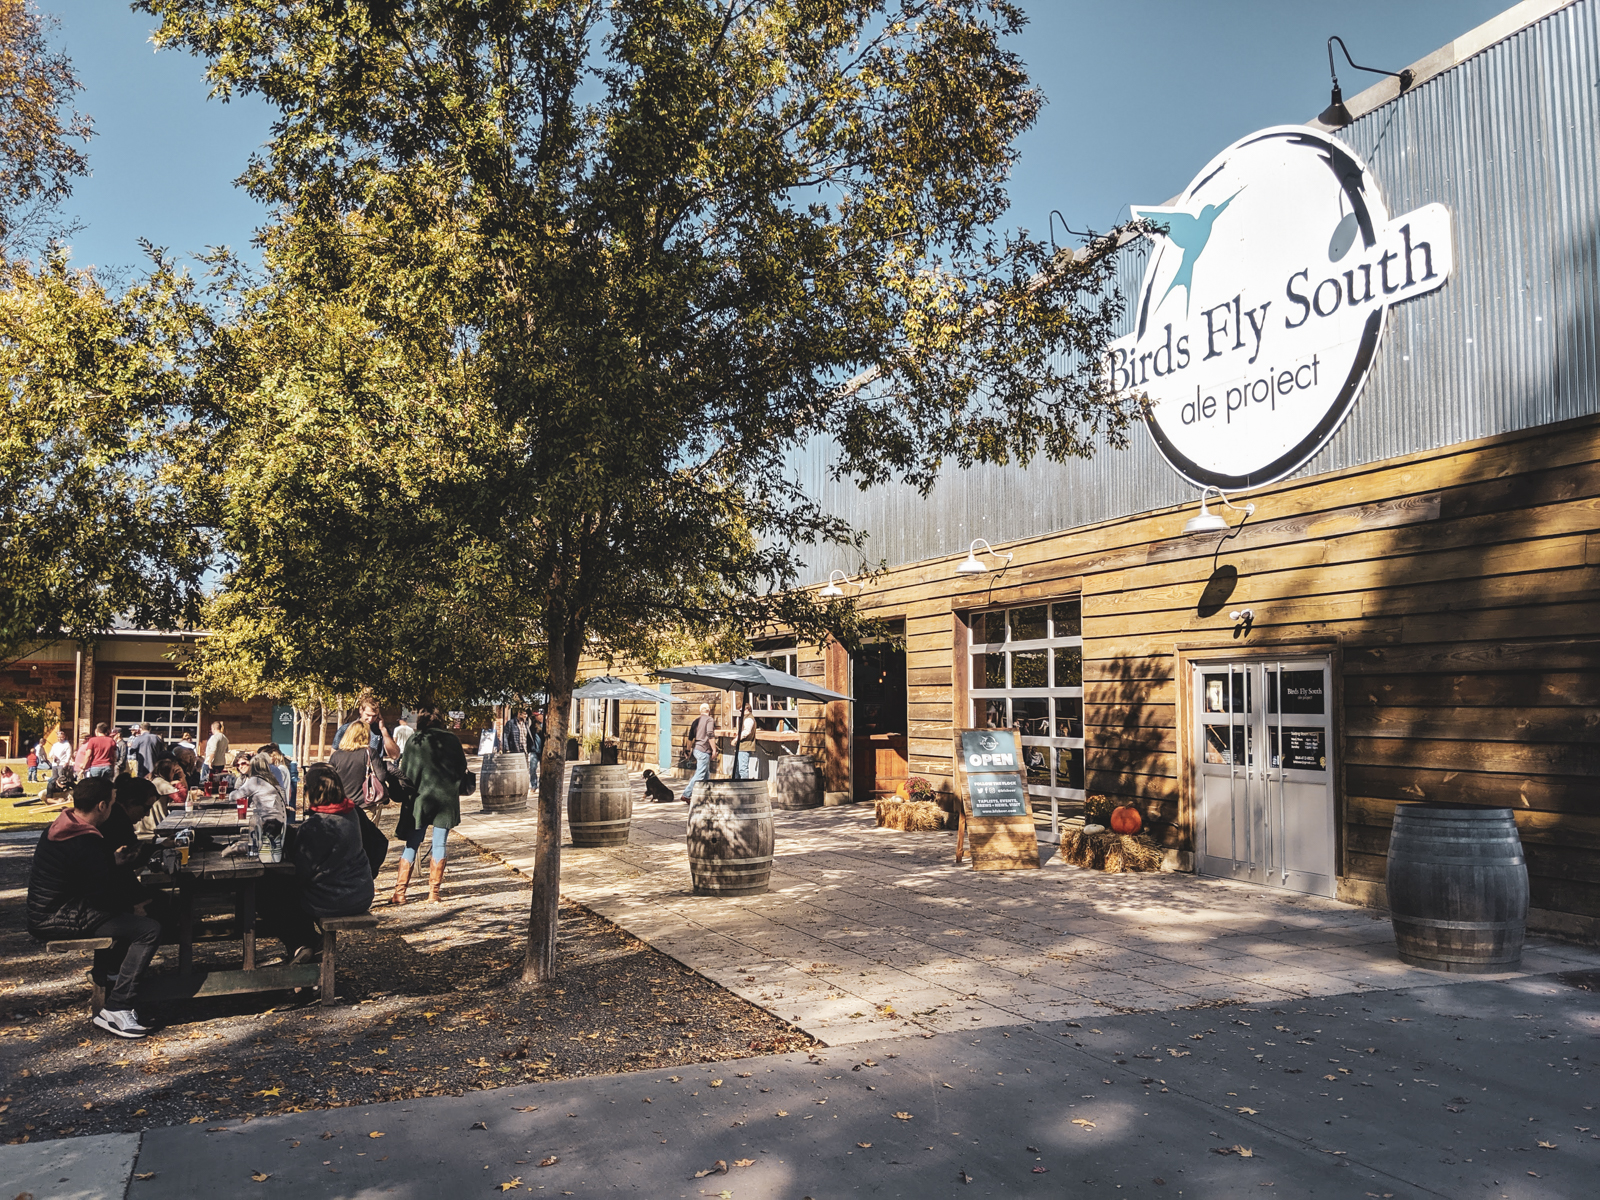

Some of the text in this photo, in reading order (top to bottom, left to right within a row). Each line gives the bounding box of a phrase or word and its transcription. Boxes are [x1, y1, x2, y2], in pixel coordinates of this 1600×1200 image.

[1107, 224, 1438, 394] Birds Fly South
[1181, 353, 1320, 425] ale project
[1308, 687, 1322, 695] South
[969, 753, 1014, 766] OPEN
